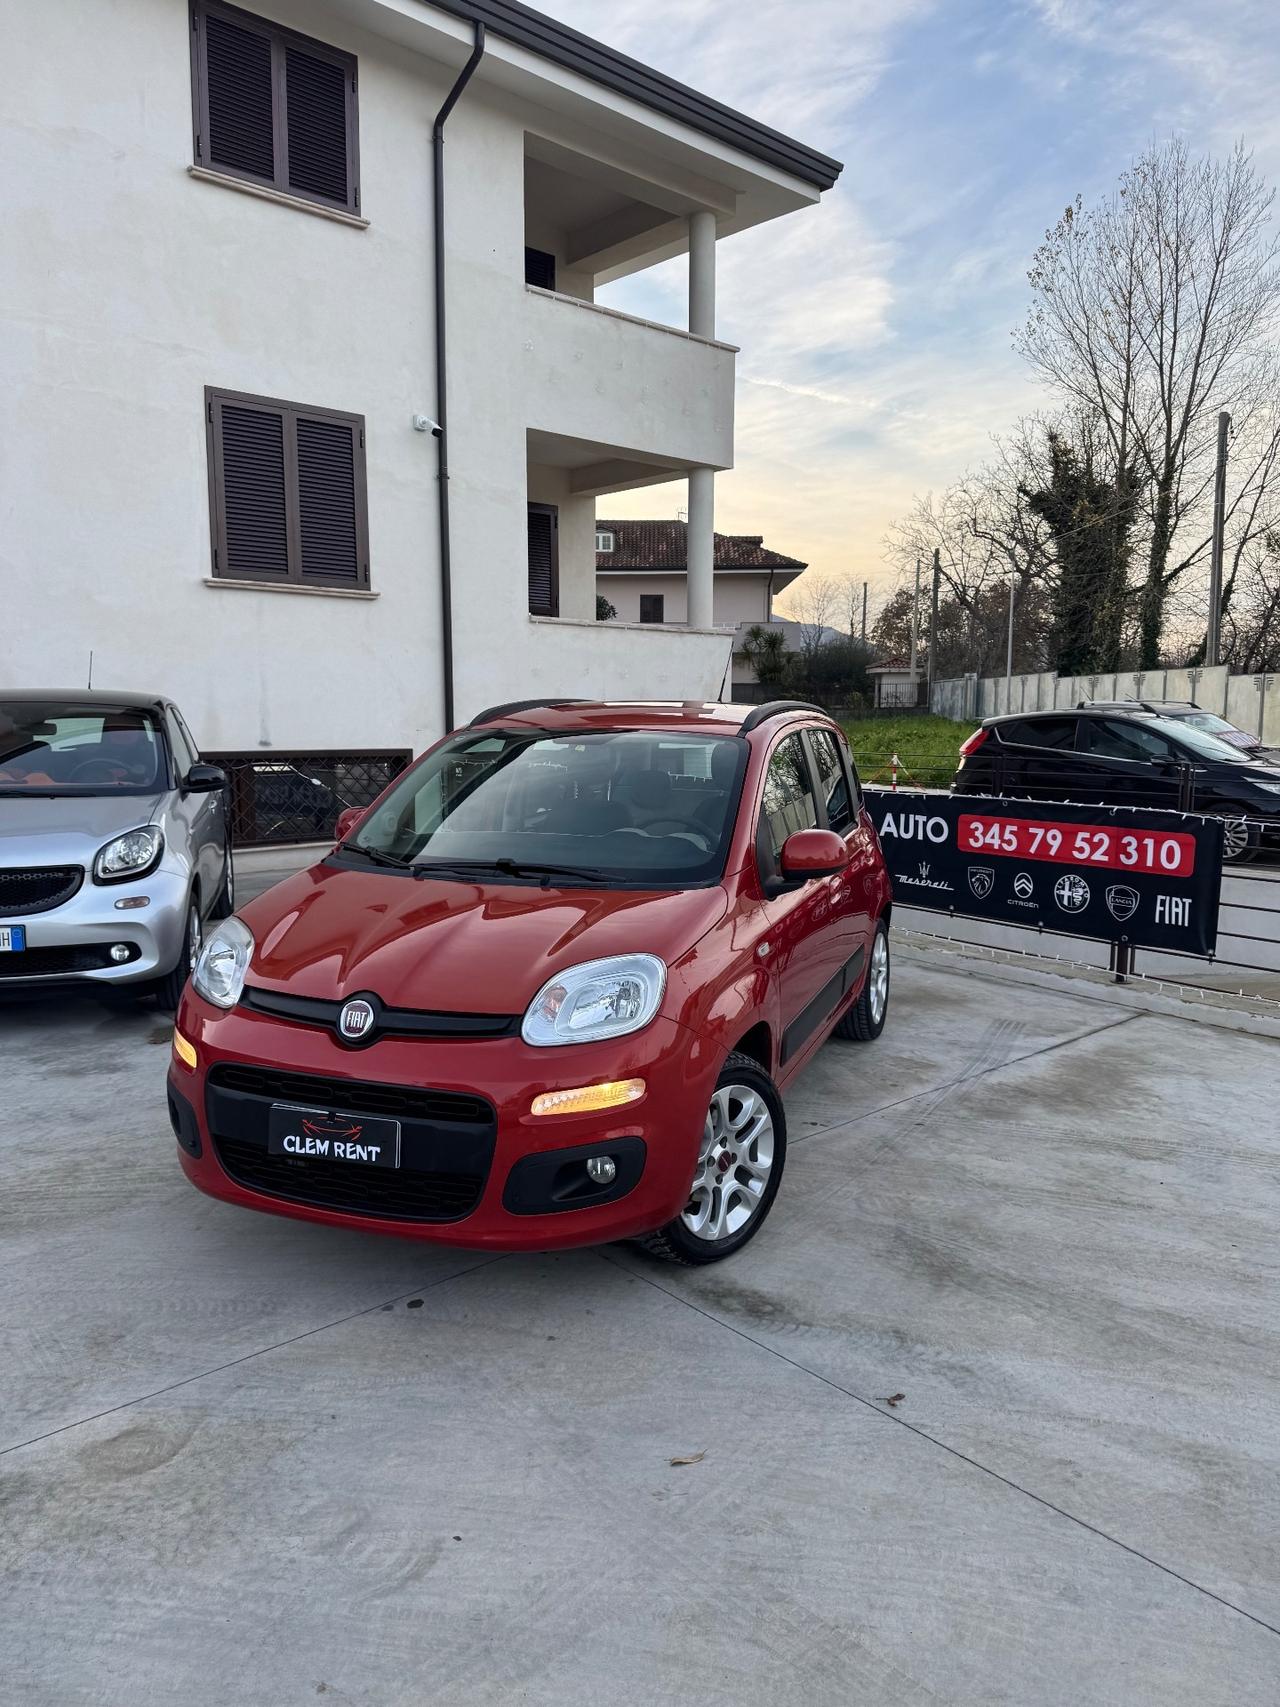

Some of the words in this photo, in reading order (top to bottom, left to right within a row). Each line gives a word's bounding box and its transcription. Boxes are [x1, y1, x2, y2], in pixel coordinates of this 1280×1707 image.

[879, 813, 949, 843] AUTO
[968, 821, 1018, 852] 345
[1028, 827, 1063, 857] 79
[1072, 831, 1110, 862] 52
[1119, 835, 1181, 870] 310
[1154, 894, 1193, 927] FIAT
[346, 1010, 367, 1029] FIAT
[283, 1135, 330, 1156] CLEM
[333, 1141, 381, 1162] RENT
